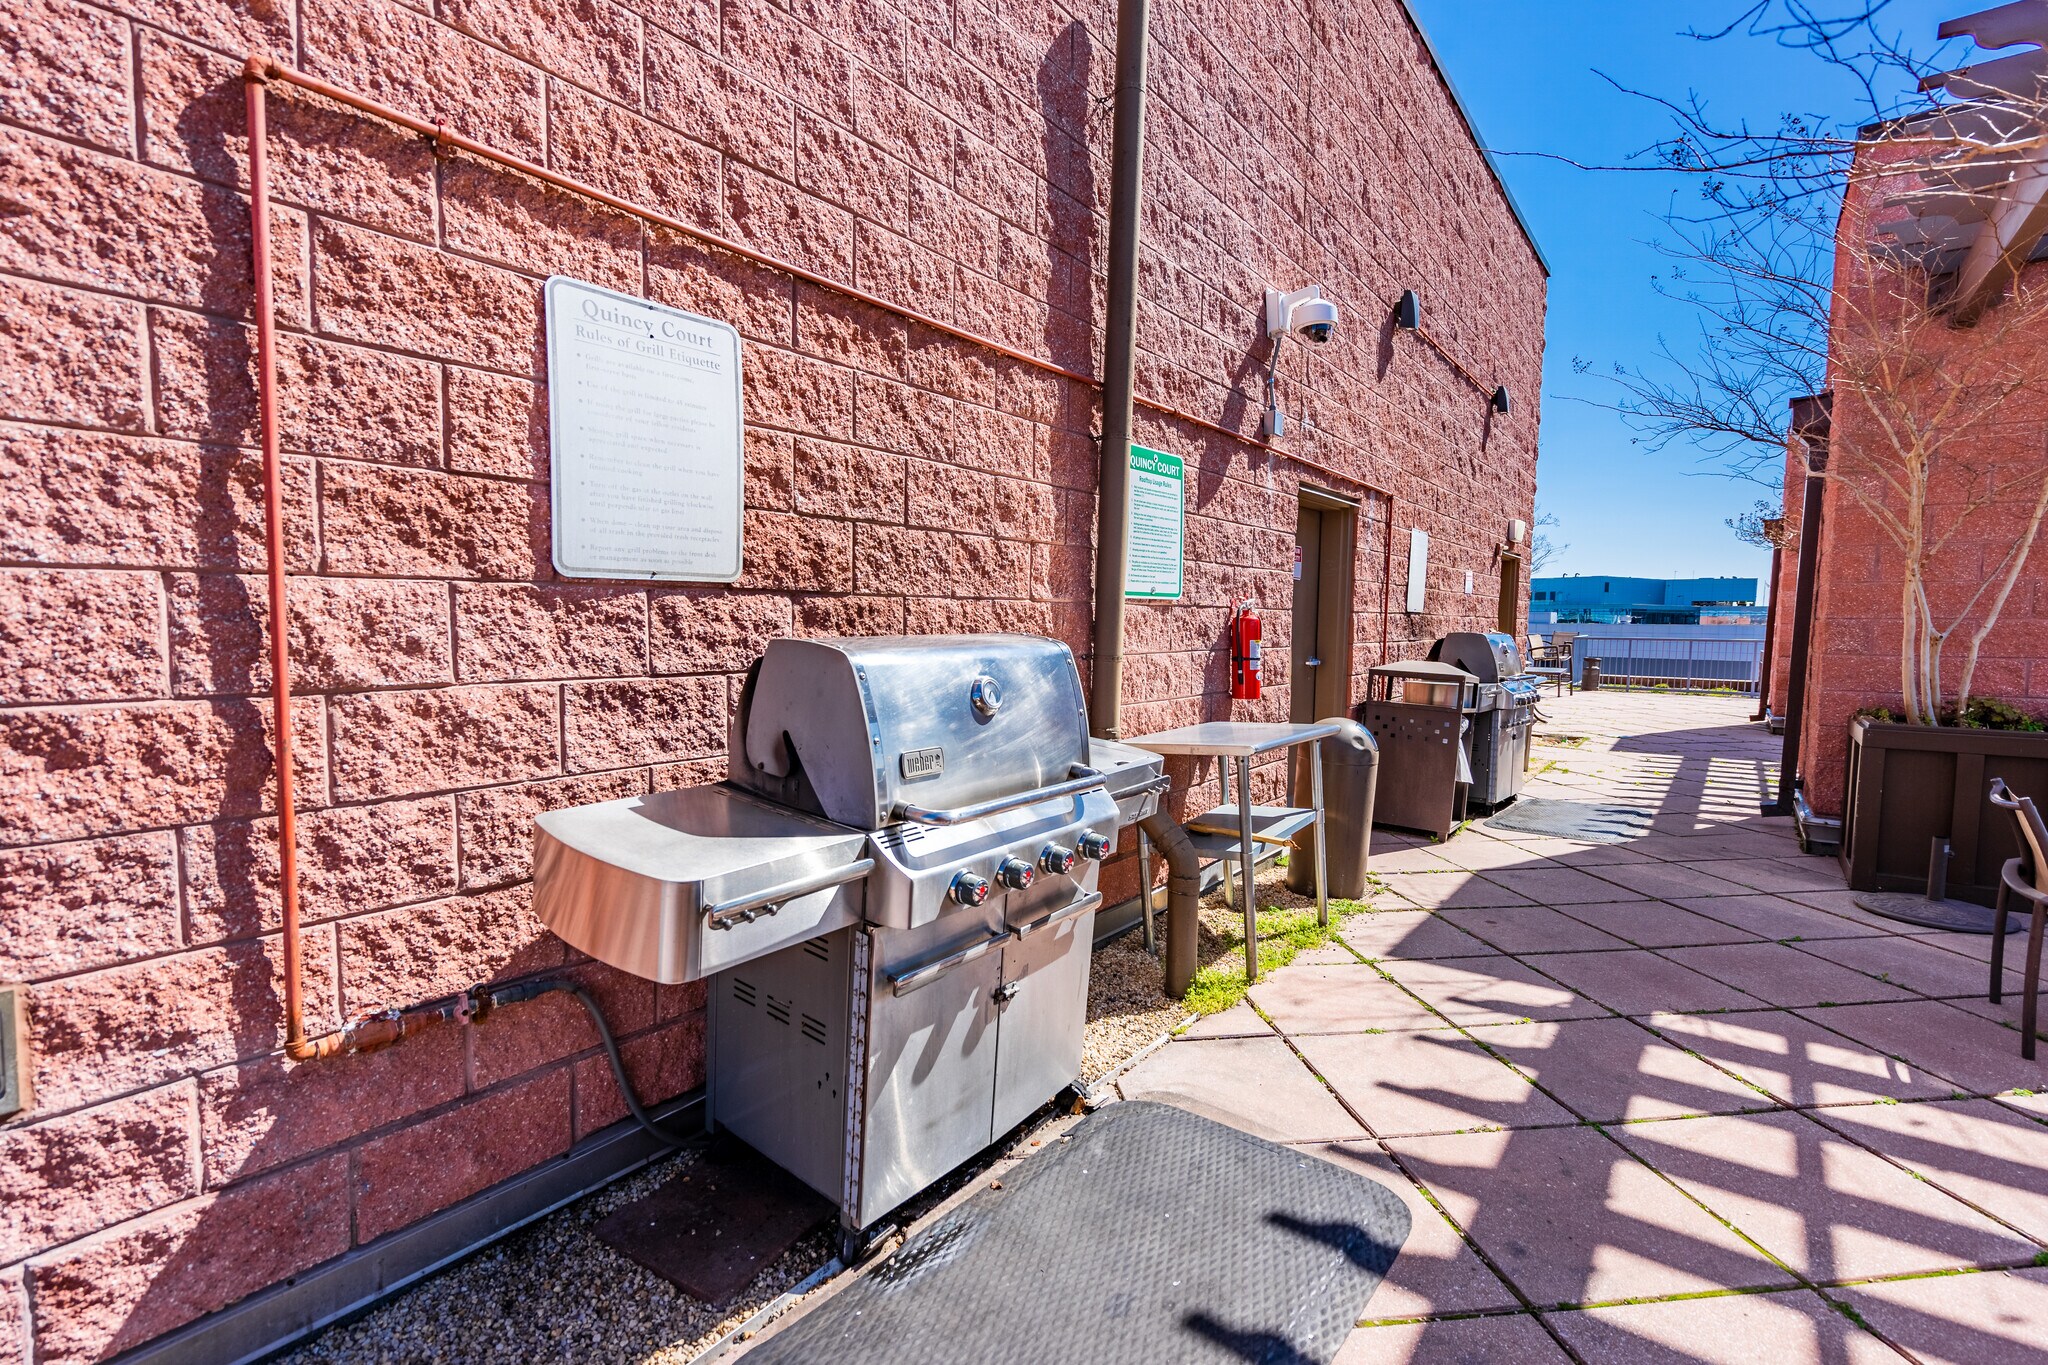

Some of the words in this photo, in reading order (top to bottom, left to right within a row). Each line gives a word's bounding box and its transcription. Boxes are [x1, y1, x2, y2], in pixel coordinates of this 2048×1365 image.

[582, 299, 653, 335] Quincy
[662, 321, 712, 347] Court
[575, 325, 612, 343] Rules
[617, 335, 631, 348] of
[636, 341, 664, 356] Grill
[670, 349, 720, 371] Etiquette
[609, 385, 620, 393] the
[622, 388, 635, 397] grill
[614, 403, 625, 411] the
[627, 406, 640, 414] grill
[615, 430, 628, 439] grill
[648, 436, 665, 444] when
[640, 444, 667, 454] expected
[663, 464, 676, 472] grill
[1130, 455, 1155, 471] QUINCY
[1157, 462, 1180, 477] COURT
[616, 467, 643, 477] cooking
[588, 480, 605, 489] Turn
[1153, 478, 1162, 487] Usage
[1163, 480, 1172, 488] Rules
[637, 495, 661, 503] finished
[663, 498, 684, 507] grilling
[702, 527, 722, 535] dispose
[646, 531, 672, 540] provided
[689, 535, 719, 543] receptacles
[589, 544, 611, 552] Report
[627, 546, 640, 554] grill
[642, 547, 668, 555] problems
[907, 752, 934, 773] weber
